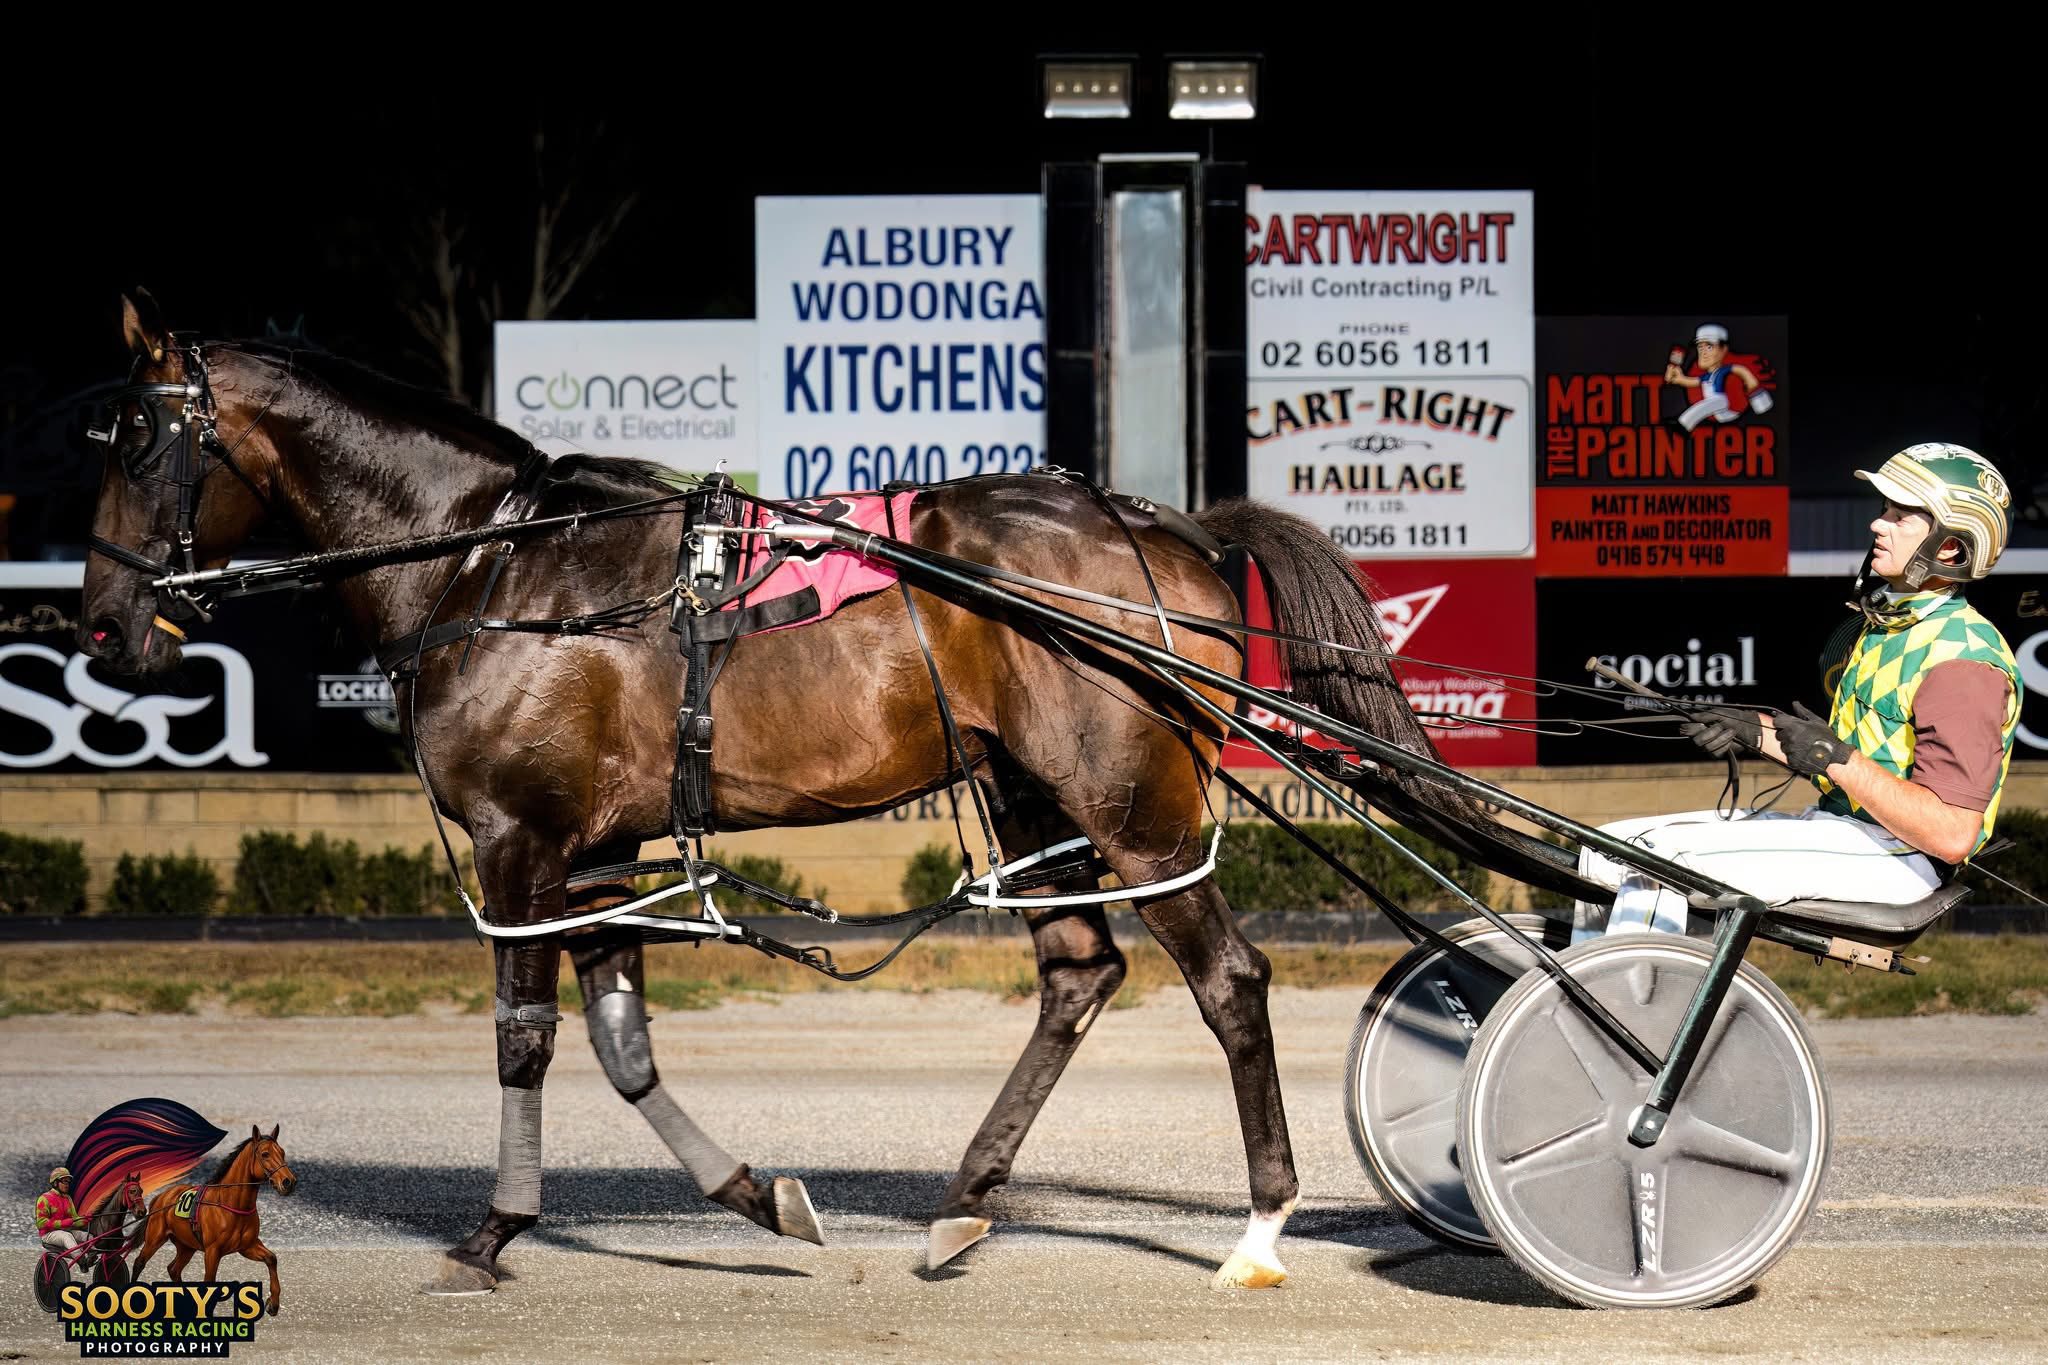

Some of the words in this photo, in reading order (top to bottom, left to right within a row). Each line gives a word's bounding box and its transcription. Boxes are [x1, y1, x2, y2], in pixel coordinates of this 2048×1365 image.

[822, 226, 1014, 267] ALBURY
[791, 280, 1045, 321] WODONGA
[1251, 277, 1303, 298] Civil
[1311, 277, 1451, 301] Contracting
[1460, 276, 1498, 297] P/L
[1339, 322, 1410, 336] PHONE
[1262, 342, 1302, 367] 02
[1315, 341, 1399, 367] 6056
[1413, 340, 1491, 366] 1811
[516, 363, 738, 411] connect
[784, 343, 1047, 413] KITCHENS
[521, 415, 584, 440] Solar
[592, 416, 612, 440] &
[621, 414, 736, 440] Electrical
[785, 446, 832, 499] 02
[850, 446, 947, 491] 6040
[1290, 464, 1467, 493] HAULAGE
[1591, 496, 1638, 516] MATT
[1645, 495, 1731, 516] HAWKINS
[1330, 524, 1396, 547] 6056
[1406, 525, 1468, 546] 1811
[1551, 521, 1628, 541] PAINTER
[1632, 526, 1660, 540] AND
[1663, 520, 1772, 541] DECORATOR
[1597, 546, 1642, 566] 0416
[1690, 545, 1726, 565] 448
[1594, 636, 1758, 688] social
[318, 681, 390, 701] LOCKE
